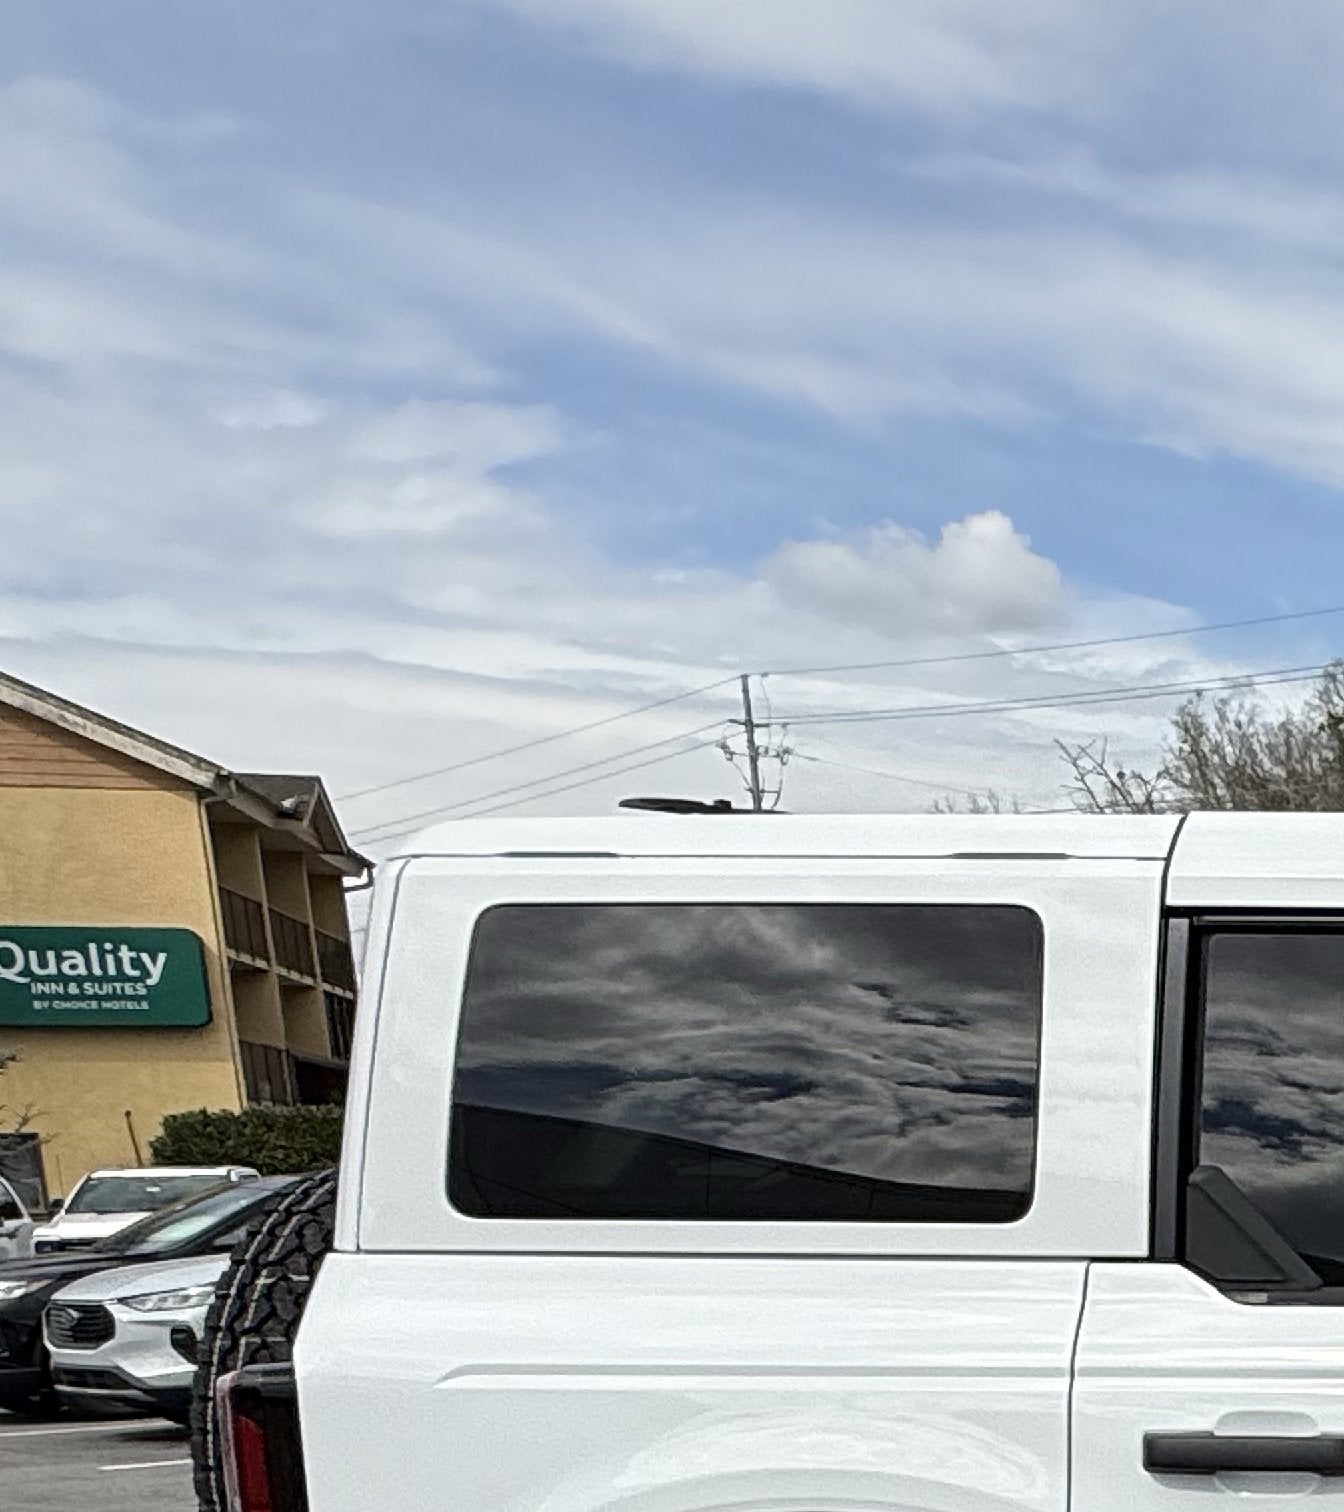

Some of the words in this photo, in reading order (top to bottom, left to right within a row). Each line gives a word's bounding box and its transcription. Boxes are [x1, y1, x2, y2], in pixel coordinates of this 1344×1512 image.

[0, 941, 167, 986] Quality
[30, 982, 65, 995] INN
[67, 982, 80, 995] &
[82, 982, 148, 996] SUITES
[32, 1000, 50, 1010] BY
